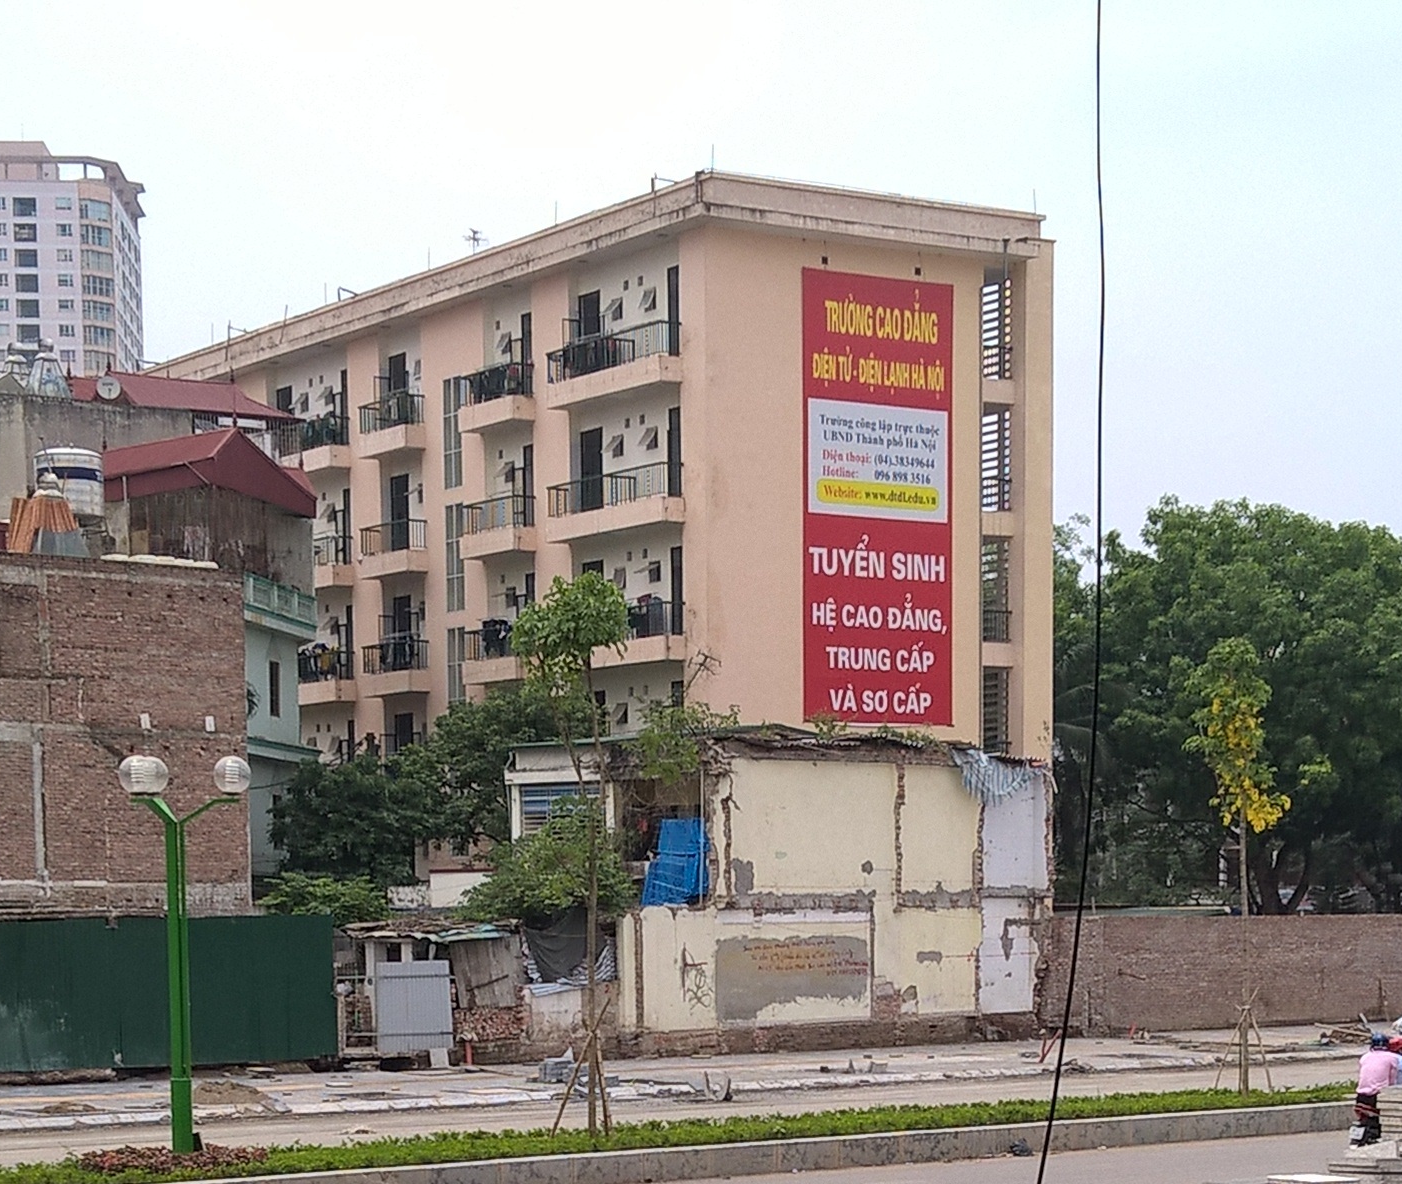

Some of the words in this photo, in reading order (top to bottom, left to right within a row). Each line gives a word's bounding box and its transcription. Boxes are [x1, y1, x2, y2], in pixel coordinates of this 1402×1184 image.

[825, 294, 873, 336] TRƯỜNG
[876, 306, 901, 340] CAO
[904, 289, 938, 344] ĐẲNG
[813, 348, 836, 387] ĐIỆN
[838, 346, 853, 381] TỬ
[859, 352, 882, 392] ĐIỆN
[884, 362, 910, 394] LẠNH
[911, 359, 925, 390] HÀ
[927, 361, 944, 399] NỘI
[823, 430, 852, 443] UBND
[824, 485, 862, 498] Website:
[874, 470, 890, 480] 096
[911, 473, 931, 484] 3516
[809, 535, 885, 579] TUYỂN
[892, 553, 946, 582] SINH
[812, 597, 837, 632] HỆ
[842, 605, 882, 628] CAO
[887, 593, 947, 634] ĐẲNG,
[826, 647, 891, 671] TRUNG
[896, 641, 934, 672] CẤP
[830, 684, 857, 712] VÀ
[862, 690, 888, 713] SƠ
[893, 683, 932, 714] CẤP
